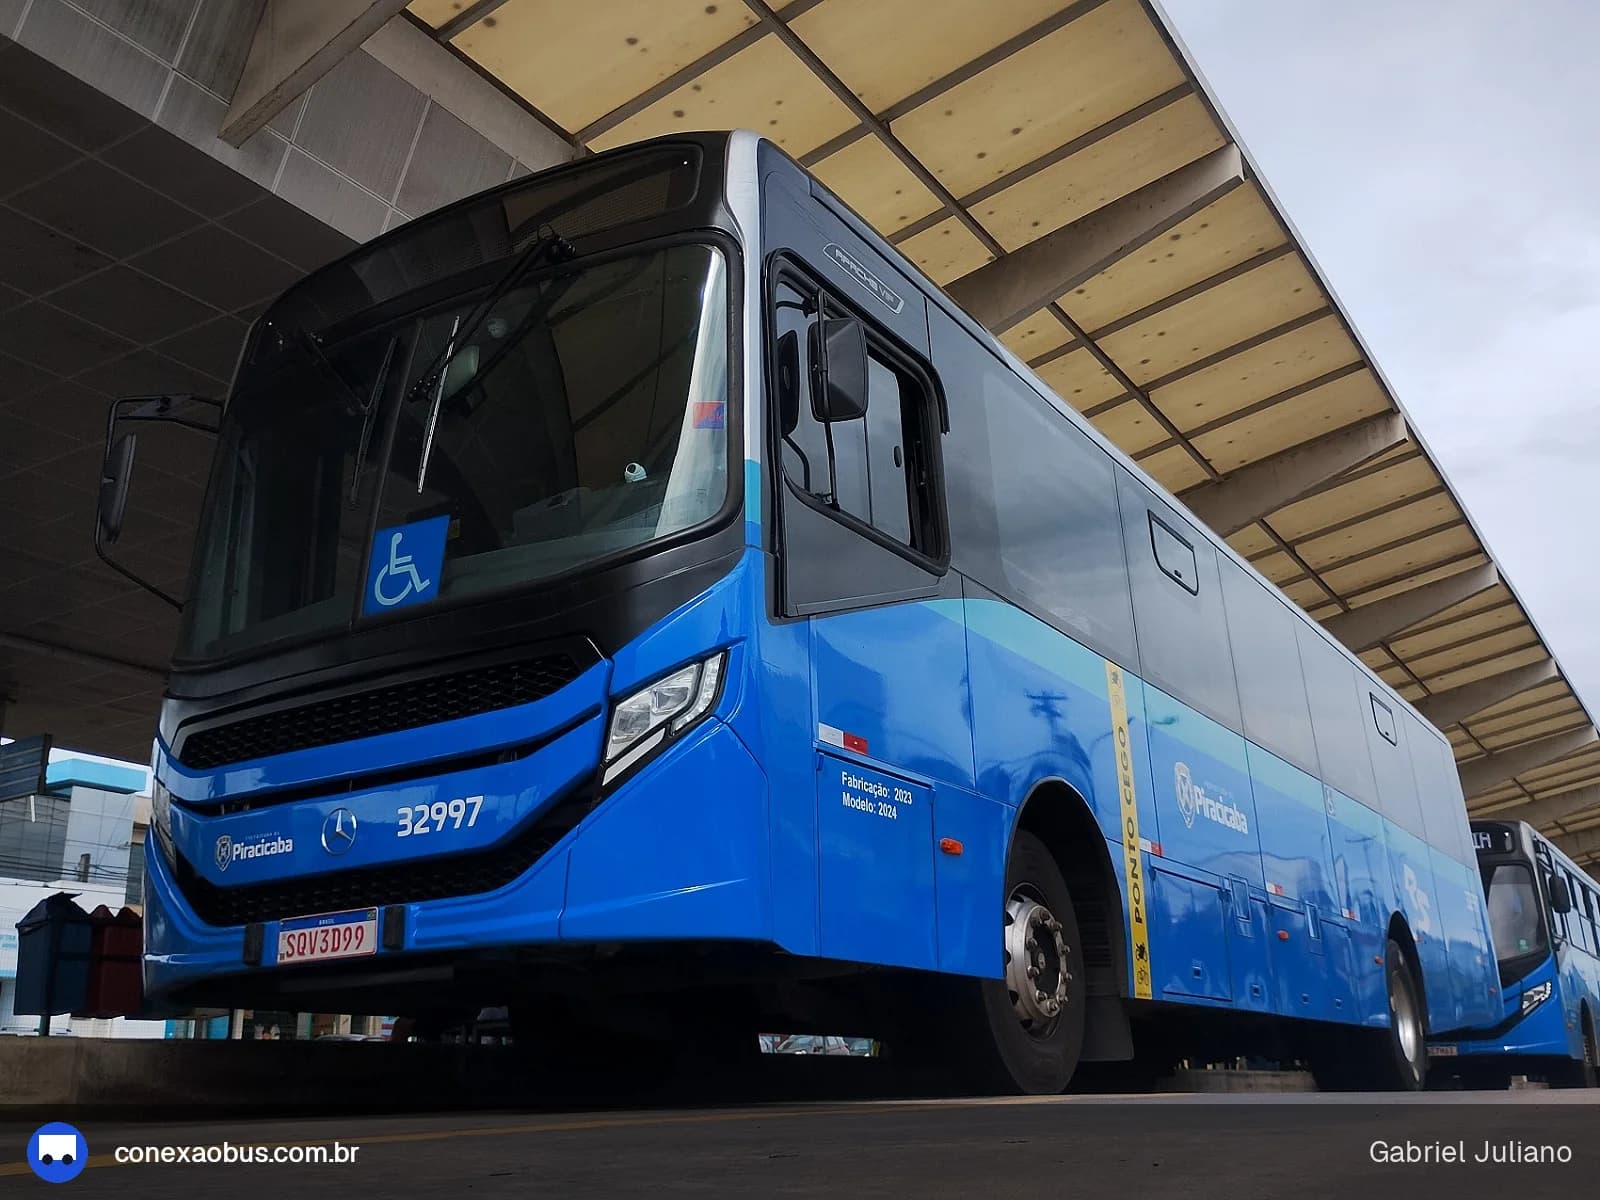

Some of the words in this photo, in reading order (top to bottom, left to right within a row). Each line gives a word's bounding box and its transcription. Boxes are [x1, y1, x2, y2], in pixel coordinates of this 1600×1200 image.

[1118, 725, 1132, 806] CEGO
[841, 771, 891, 799] Fabricação:
[894, 787, 913, 805] 2023
[842, 791, 877, 814] Modelo:
[878, 801, 897, 820] 2024
[397, 795, 484, 837] 32997
[1193, 784, 1248, 835] Piracicaba
[232, 836, 294, 861] Piracicaba
[1126, 816, 1144, 925] PONTO
[286, 925, 365, 958] SQV3D99
